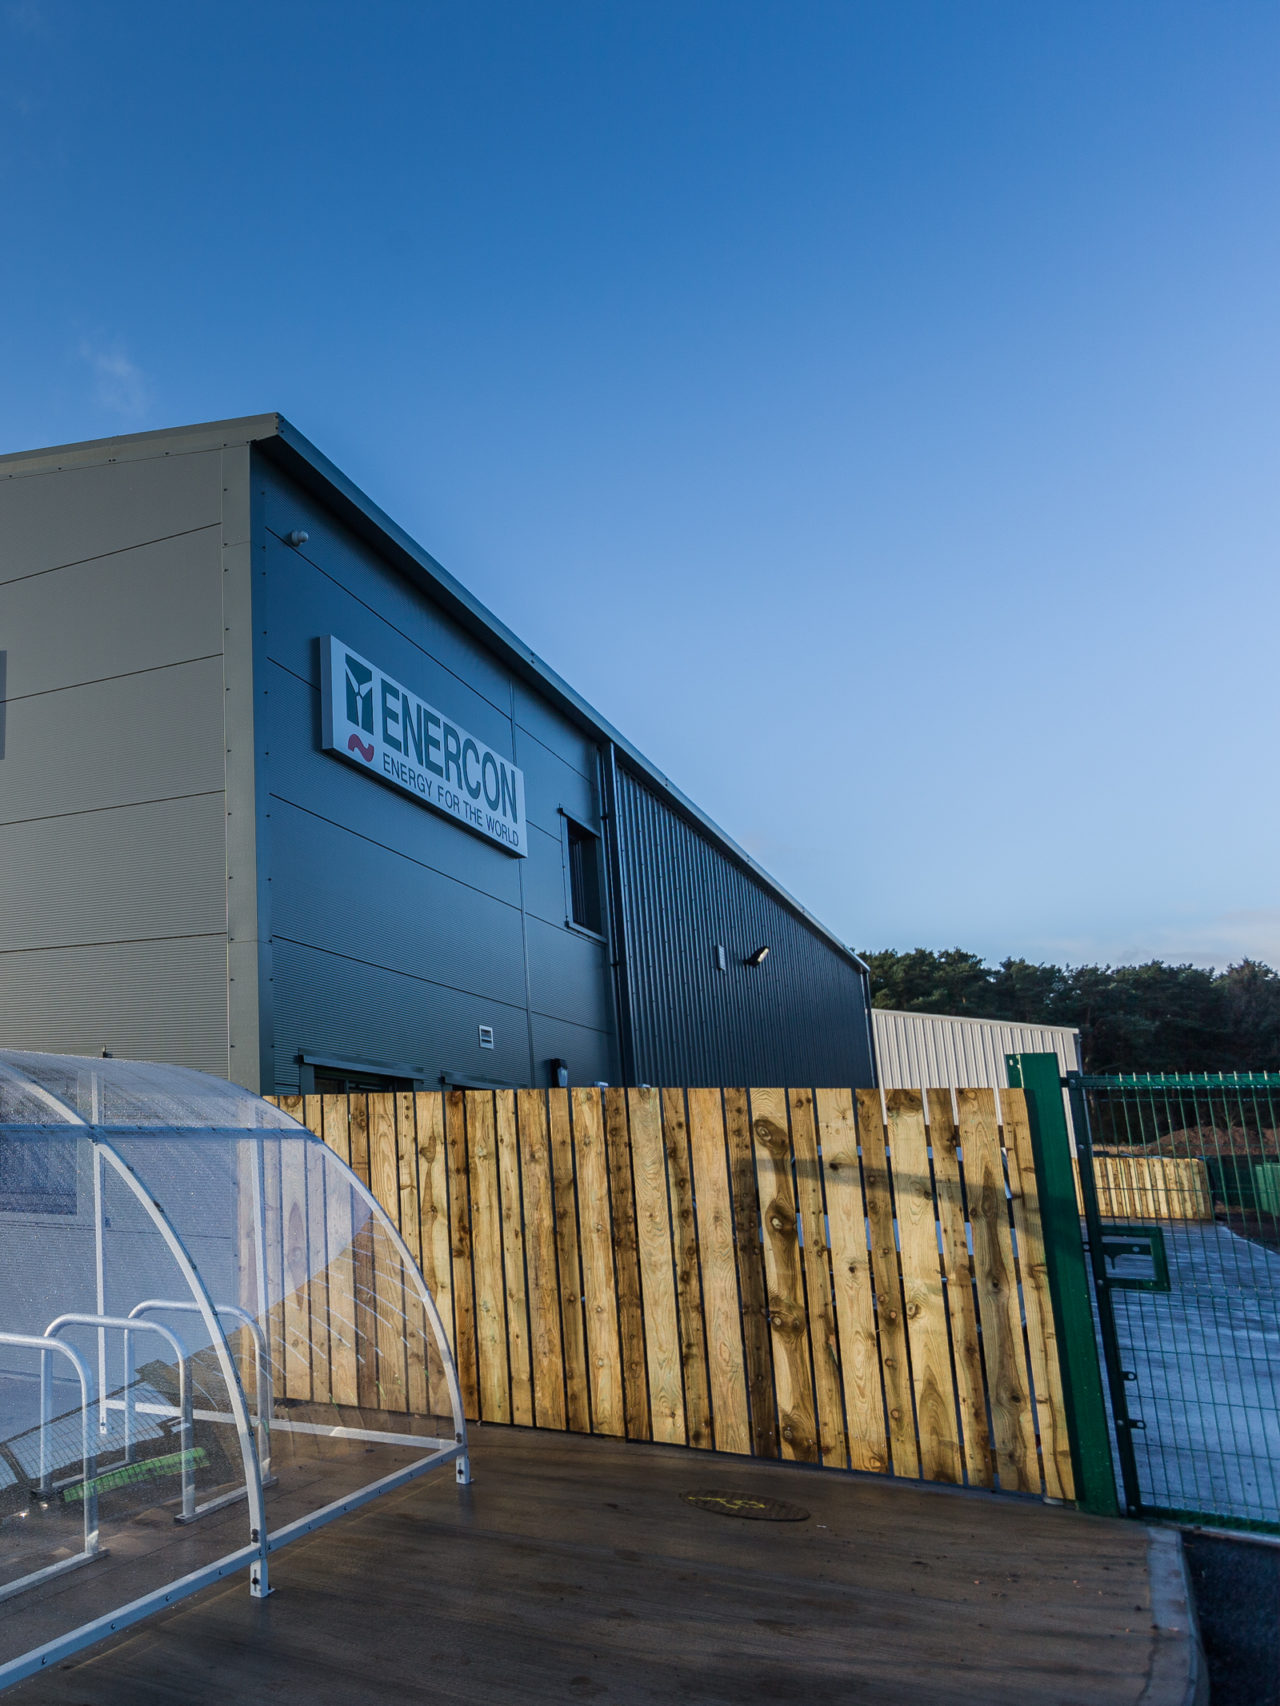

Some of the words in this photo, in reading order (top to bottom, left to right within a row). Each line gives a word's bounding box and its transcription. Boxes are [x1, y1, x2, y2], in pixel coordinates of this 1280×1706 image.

[381, 678, 518, 824] ENERCON
[383, 752, 433, 796] ENERGY
[438, 785, 460, 813] FOR
[463, 799, 483, 827] THE
[486, 815, 519, 847] WORLD
